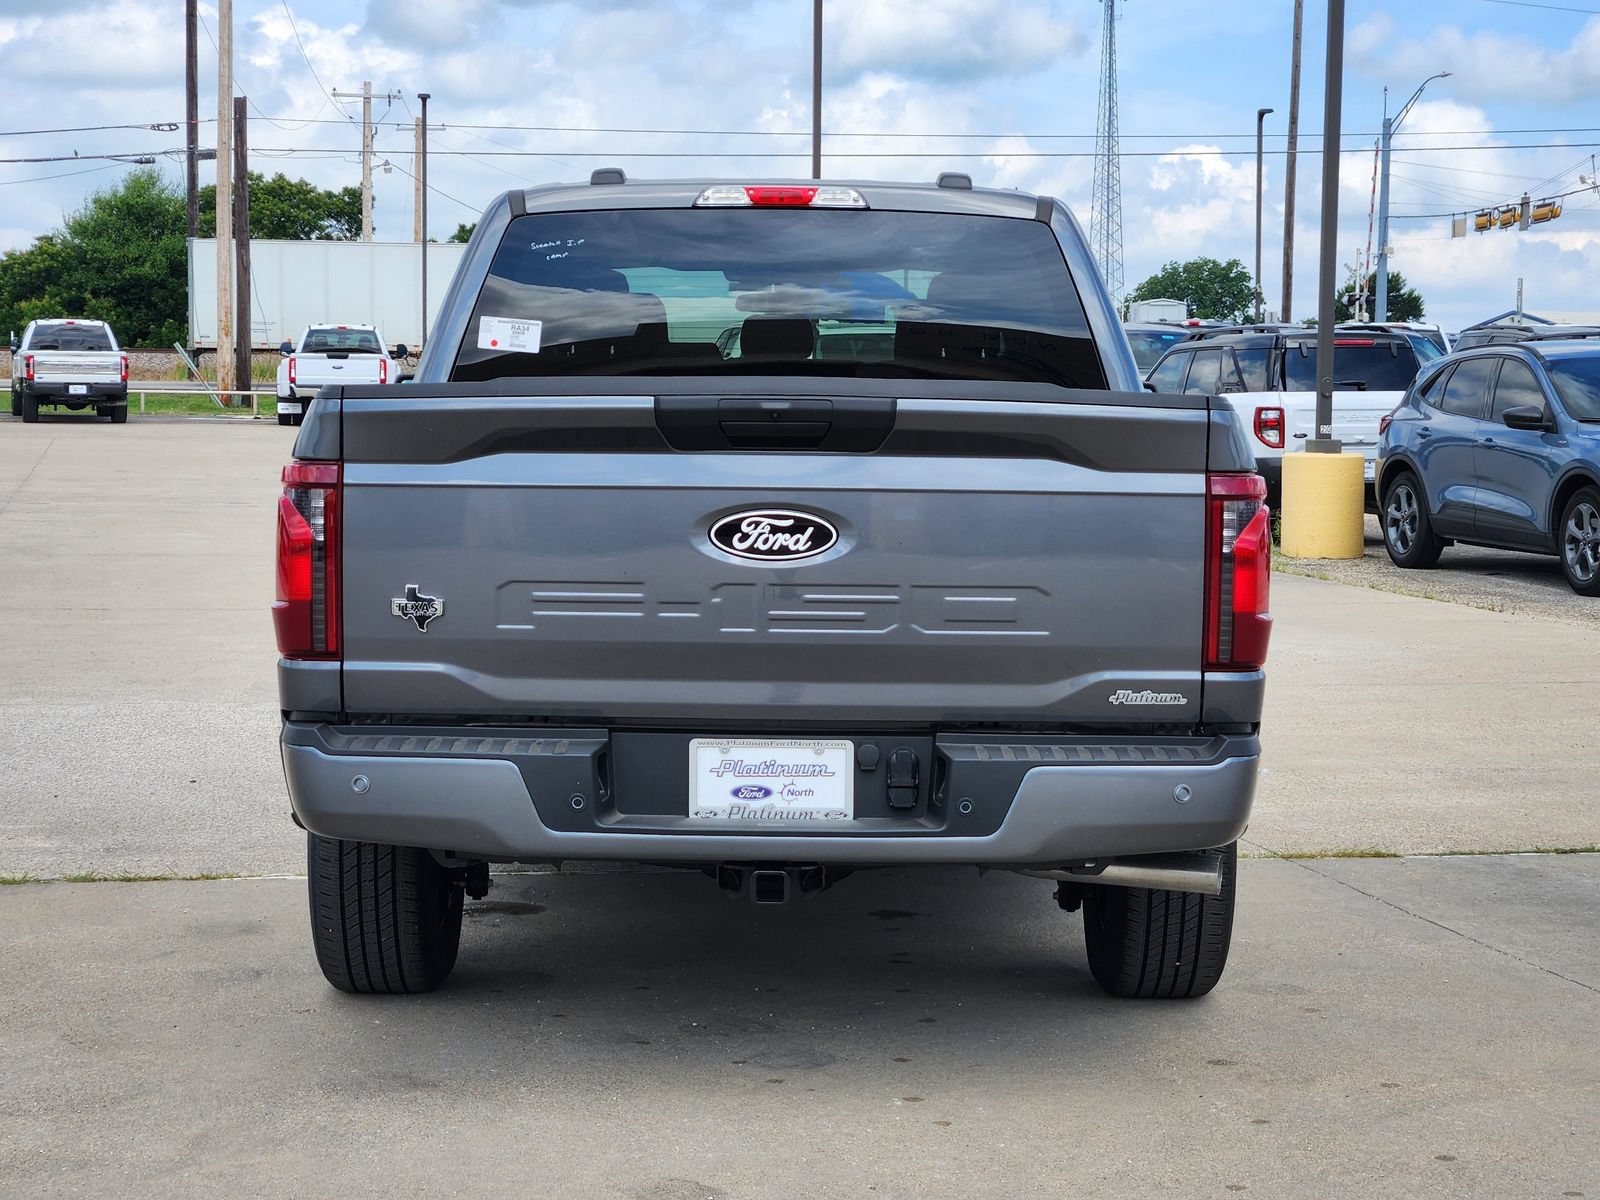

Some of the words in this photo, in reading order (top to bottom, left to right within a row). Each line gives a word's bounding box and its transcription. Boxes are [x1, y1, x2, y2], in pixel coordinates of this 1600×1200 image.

[732, 516, 815, 551] Ford
[394, 601, 438, 613] TEXAS
[1108, 690, 1187, 705] Platinum
[697, 740, 847, 748] www.PlatinumFordNorth.com
[709, 759, 836, 777] Platinum
[738, 786, 765, 799] Ford
[786, 788, 814, 797] North
[728, 805, 819, 820] Platinum
